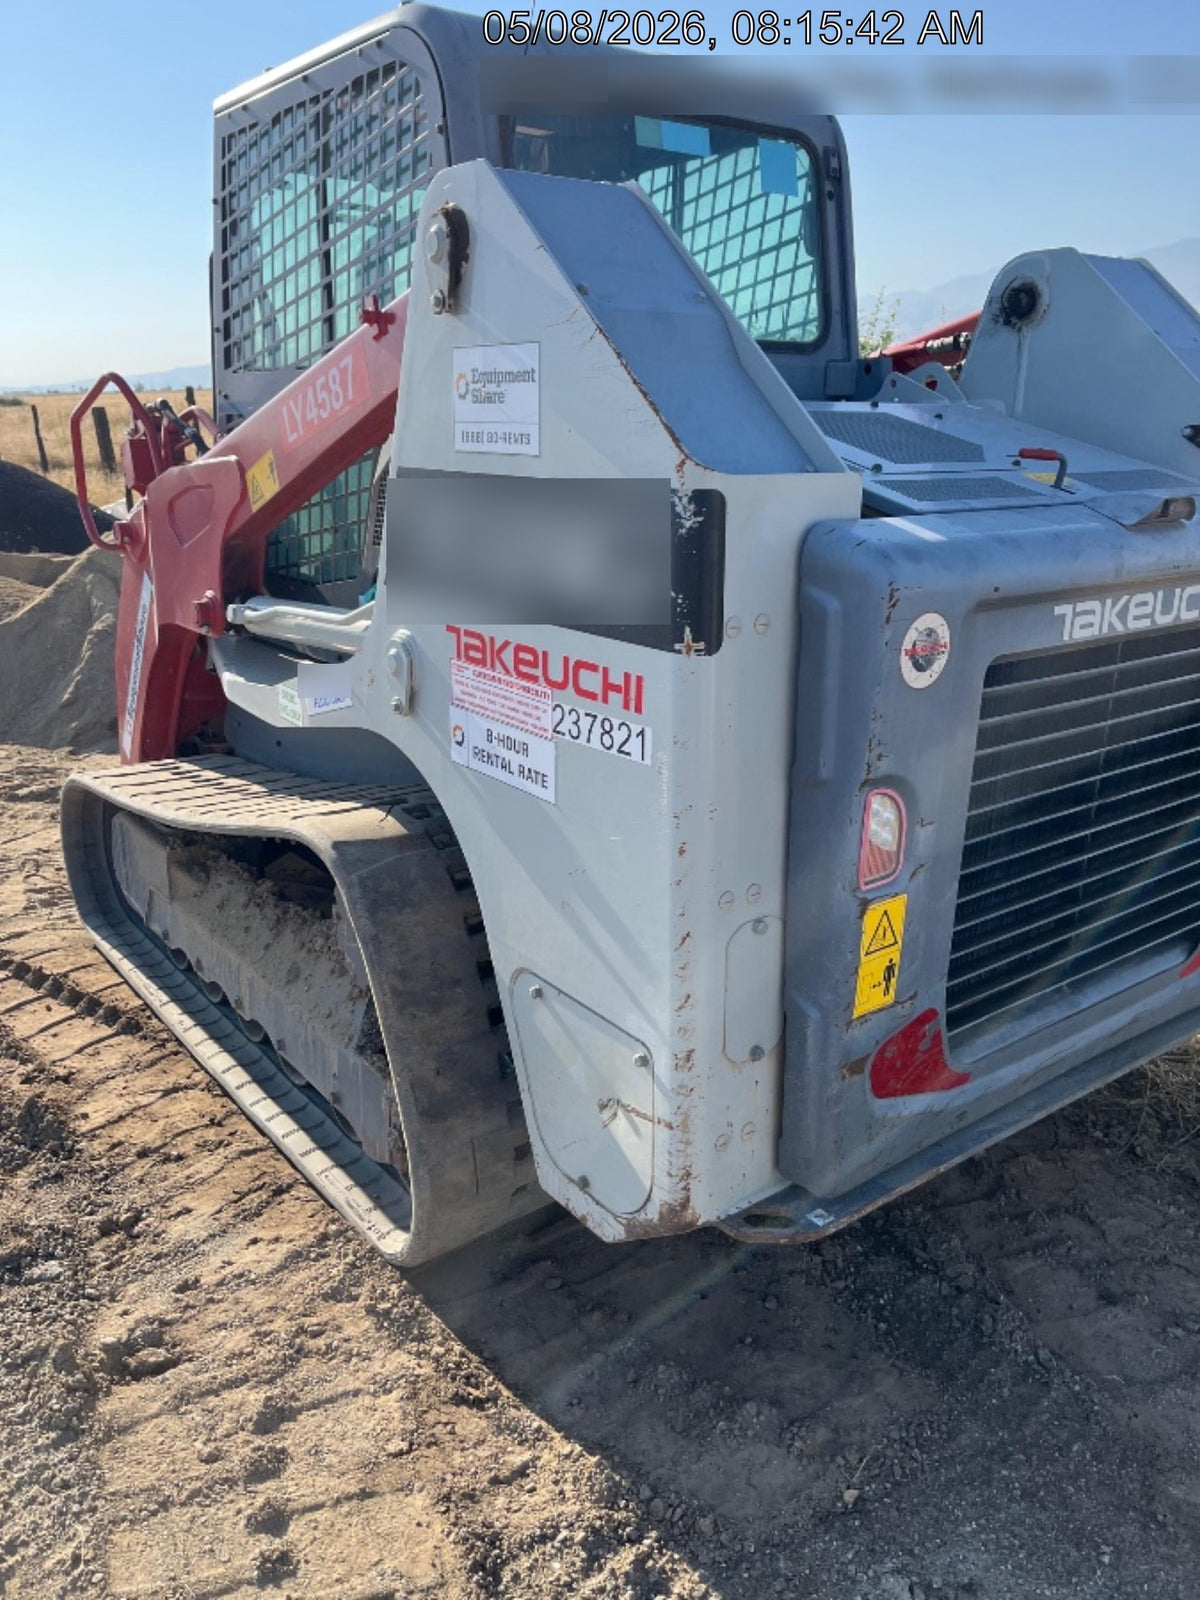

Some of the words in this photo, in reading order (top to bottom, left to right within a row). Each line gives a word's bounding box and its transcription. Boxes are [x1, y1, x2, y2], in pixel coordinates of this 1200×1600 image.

[282, 353, 354, 444] LY4587
[471, 367, 536, 388] Equipment
[471, 388, 505, 404] Share
[446, 624, 644, 715] TAKEUCHI
[552, 703, 646, 762] 237821
[472, 745, 515, 776] RENTAL
[518, 763, 549, 790] RATE
